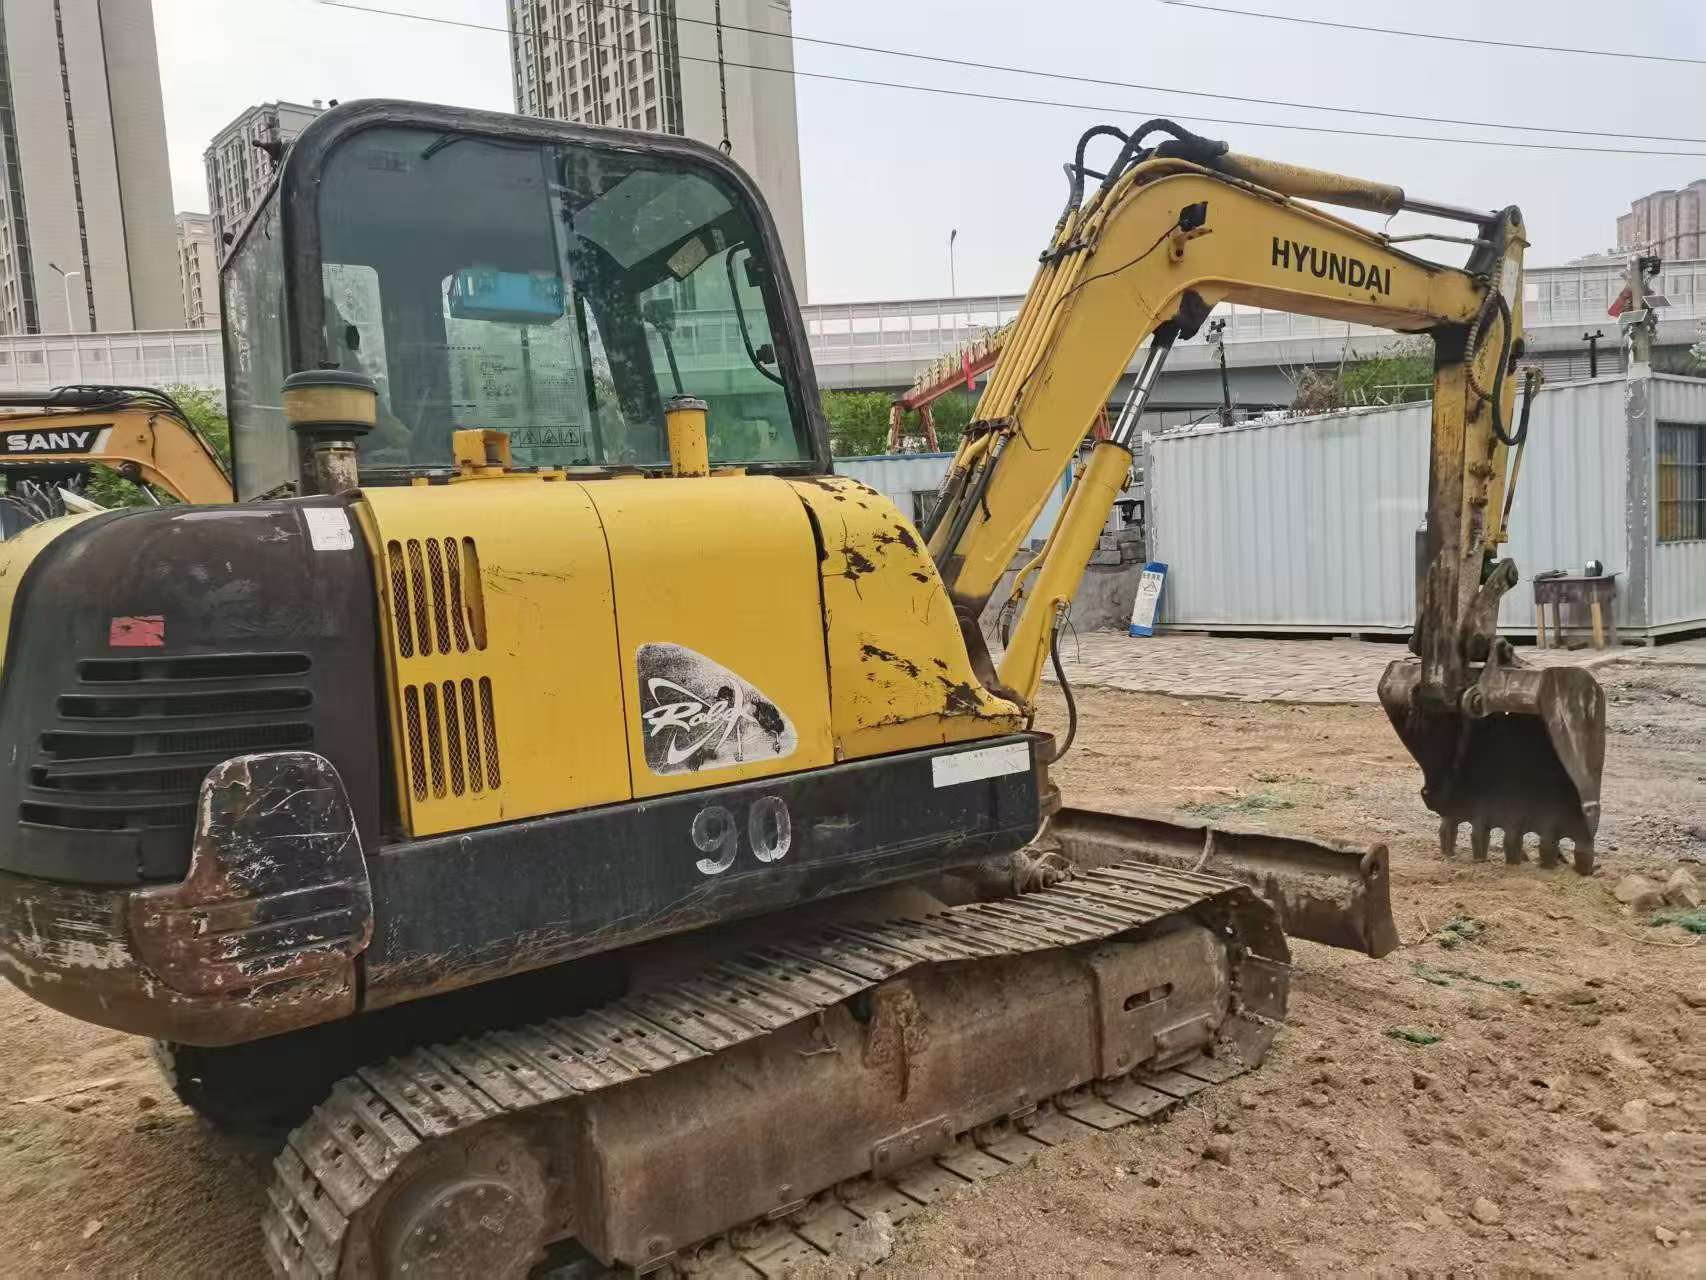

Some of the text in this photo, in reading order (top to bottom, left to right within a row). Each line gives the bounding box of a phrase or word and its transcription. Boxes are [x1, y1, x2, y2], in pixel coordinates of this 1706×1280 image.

[1271, 236, 1391, 296] HYUNDAI
[6, 431, 90, 451] SANY
[691, 795, 792, 875] 90
